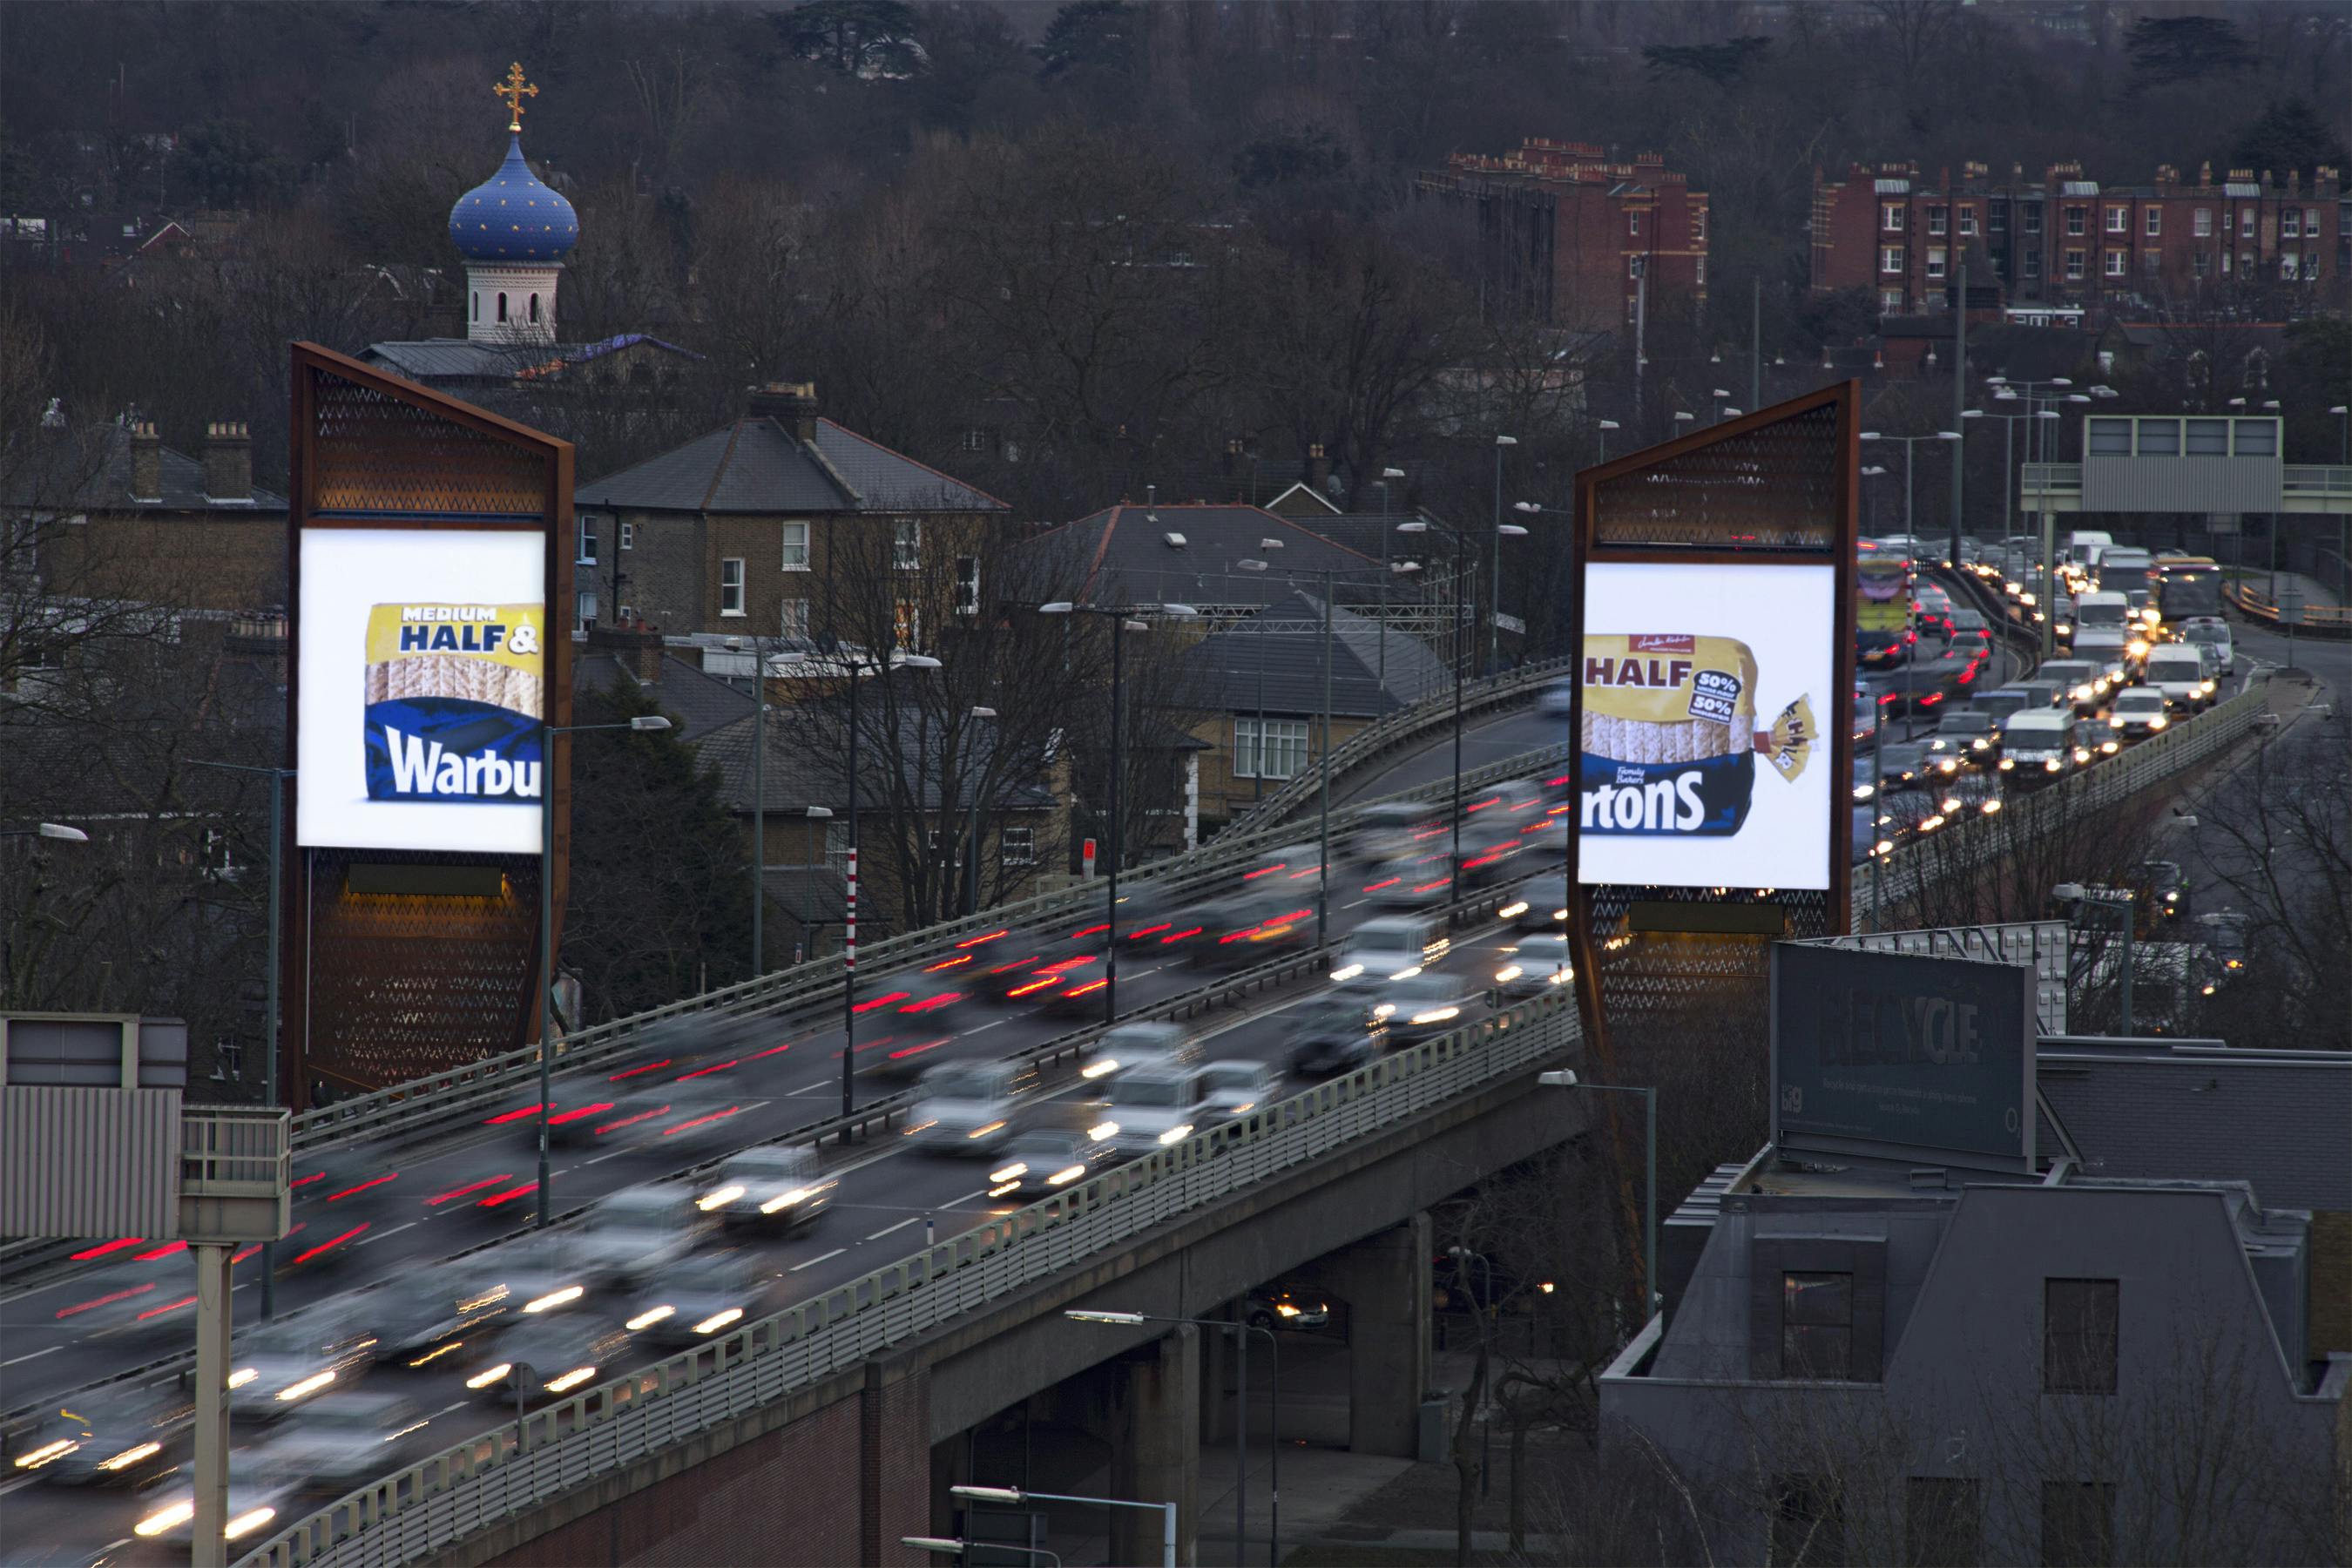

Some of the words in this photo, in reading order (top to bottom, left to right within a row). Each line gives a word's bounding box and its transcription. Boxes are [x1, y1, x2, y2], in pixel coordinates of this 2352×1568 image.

[402, 607, 497, 622] MEDIUM
[400, 625, 506, 653] HALF
[508, 625, 538, 654] &
[1585, 658, 1692, 688] HALF
[1699, 672, 1736, 692] 50%
[1693, 696, 1731, 715] 50%
[385, 725, 541, 796] Warbu
[1819, 985, 1979, 1066] RECYCLE
[1781, 1087, 1802, 1113] big
